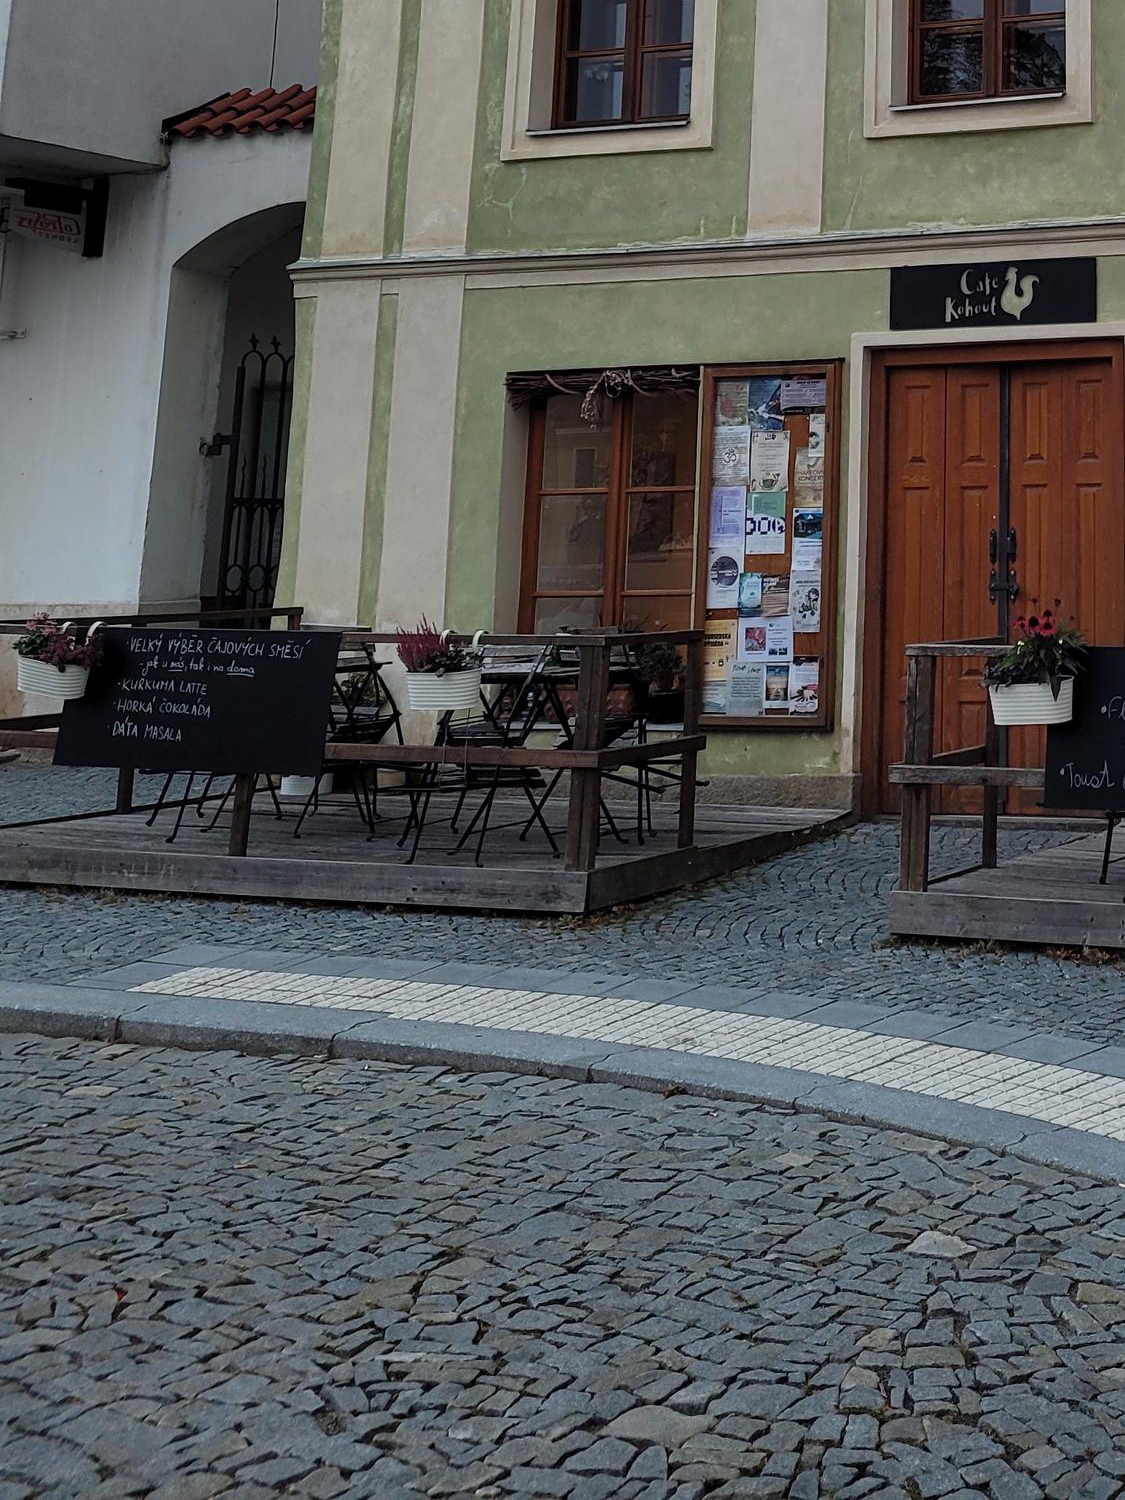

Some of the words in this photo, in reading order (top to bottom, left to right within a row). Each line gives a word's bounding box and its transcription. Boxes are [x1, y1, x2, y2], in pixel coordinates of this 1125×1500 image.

[945, 296, 997, 323] Kohout
[130, 632, 163, 653] VELKÝ
[168, 631, 203, 654] VÝBĚR
[207, 636, 263, 656] ČAJOVÝCH
[268, 638, 311, 659] SMĚSÍ
[189, 658, 204, 670] tak
[226, 660, 255, 674] doma
[121, 677, 175, 693] KURKUMA
[179, 680, 208, 695] LATTE
[117, 695, 157, 715] HORKÁ
[158, 697, 211, 719] ČOKOLÁDA
[144, 723, 182, 743] MASALA
